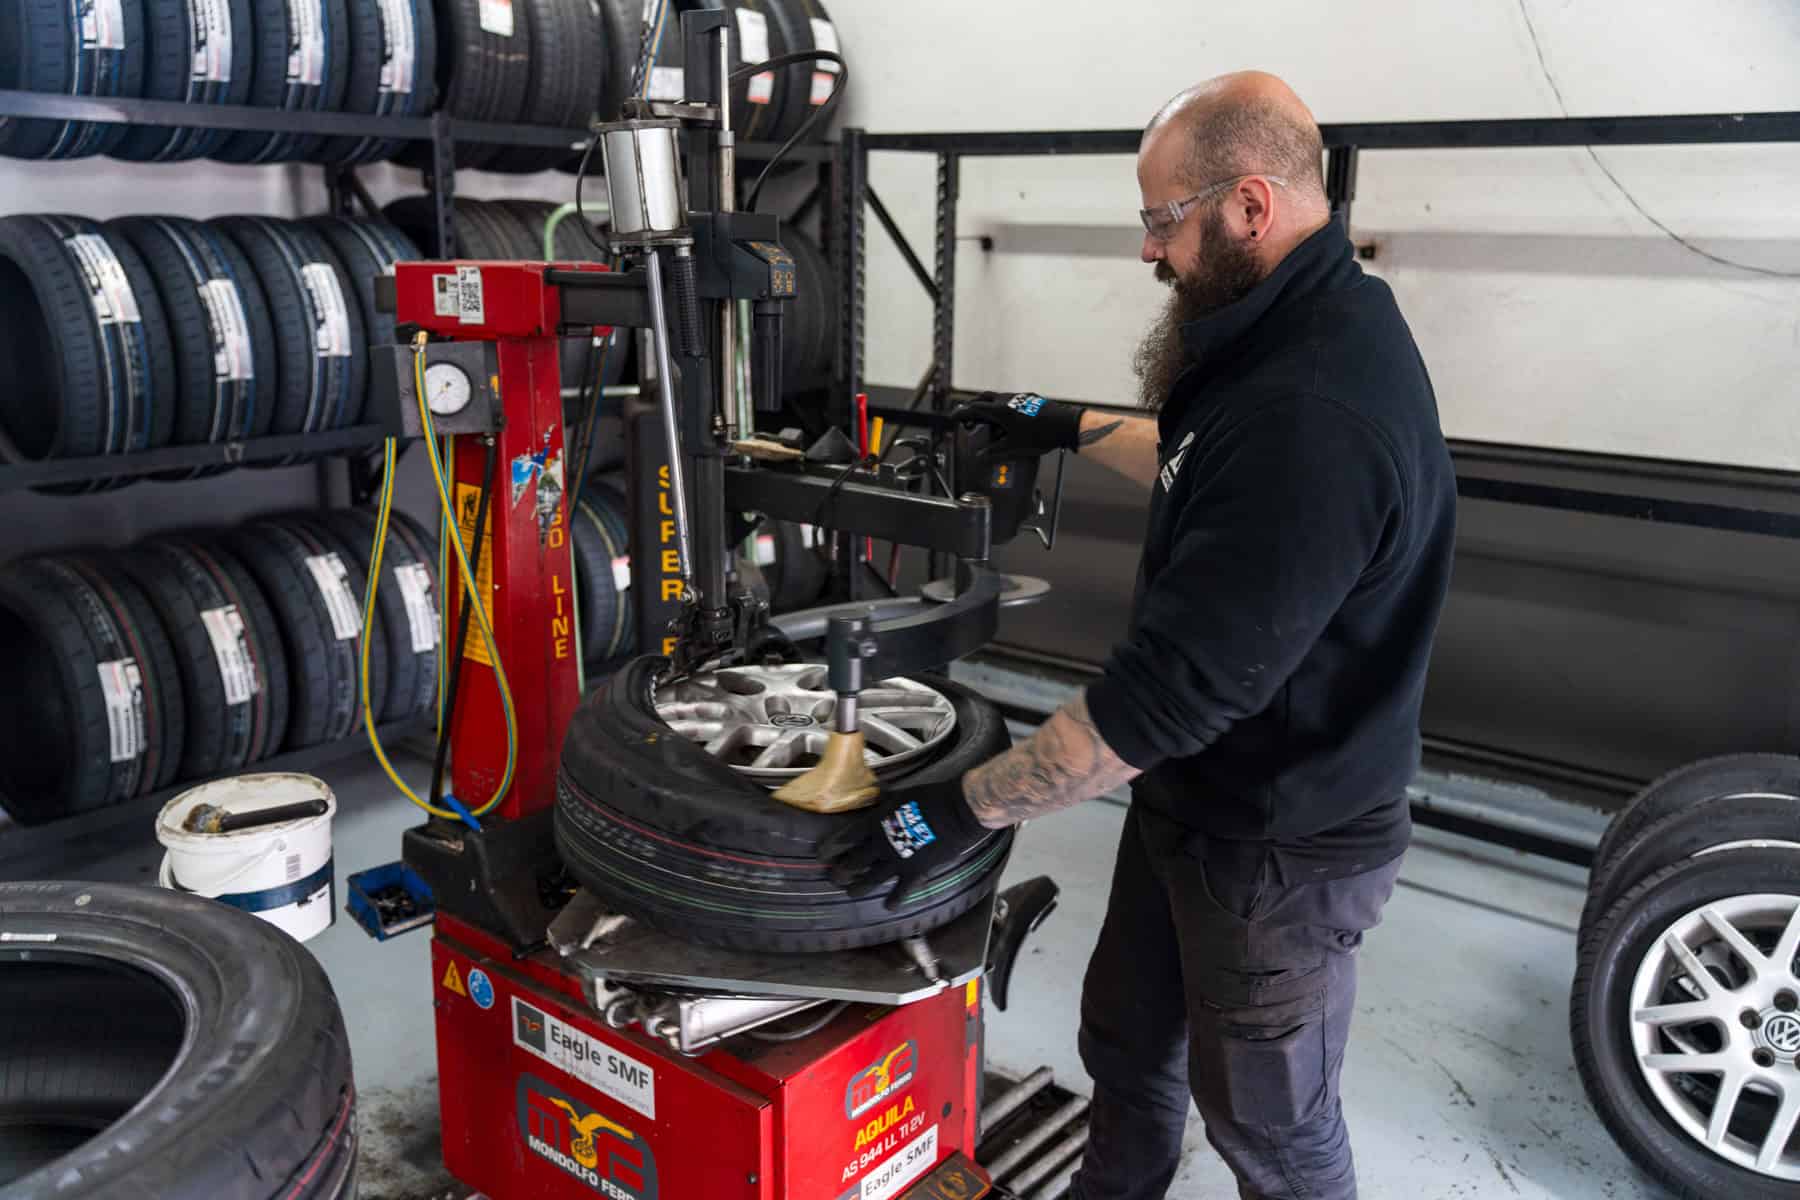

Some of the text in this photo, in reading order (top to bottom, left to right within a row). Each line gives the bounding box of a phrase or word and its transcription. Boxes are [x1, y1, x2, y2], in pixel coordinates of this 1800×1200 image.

[552, 575, 569, 659] LINE
[551, 1024, 601, 1065] Eagle
[608, 1055, 649, 1089] SMF
[854, 1095, 914, 1152] AQUILA
[529, 1135, 598, 1187] MONDOLFO
[842, 1160, 858, 1183] AS
[860, 1142, 883, 1169] 944
[885, 1133, 898, 1151] LL
[865, 1135, 933, 1196] Eagle SMF
